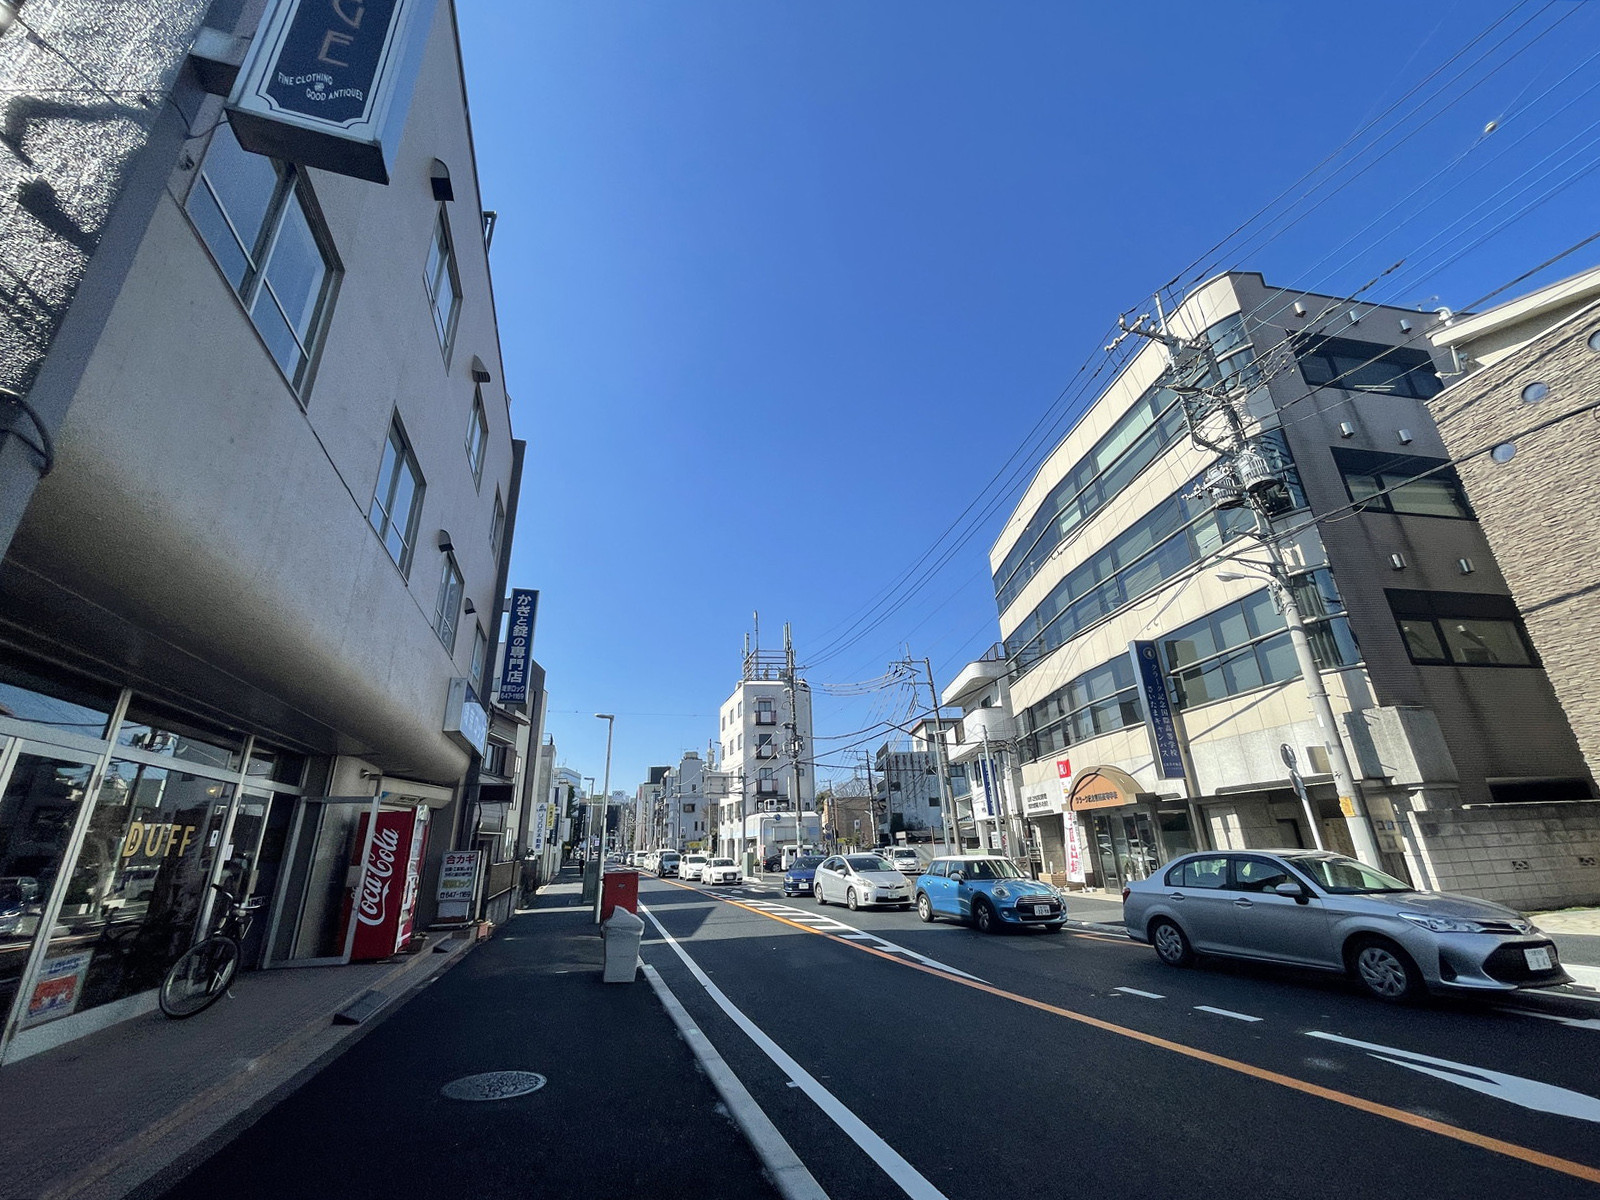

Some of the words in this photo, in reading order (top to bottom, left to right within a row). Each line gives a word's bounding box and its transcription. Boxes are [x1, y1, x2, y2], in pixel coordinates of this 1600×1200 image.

[277, 71, 294, 85] FINE
[295, 73, 333, 86] CLOTHING
[306, 88, 326, 101] GOOD
[328, 87, 363, 101] ANTIQUES
[507, 593, 532, 683] かぎと錠の専門店
[1147, 685, 1169, 757] さいたまキャンパス
[122, 821, 196, 857] DUFF
[352, 828, 399, 926] Coca-Cola
[446, 855, 475, 864] 合カギ
